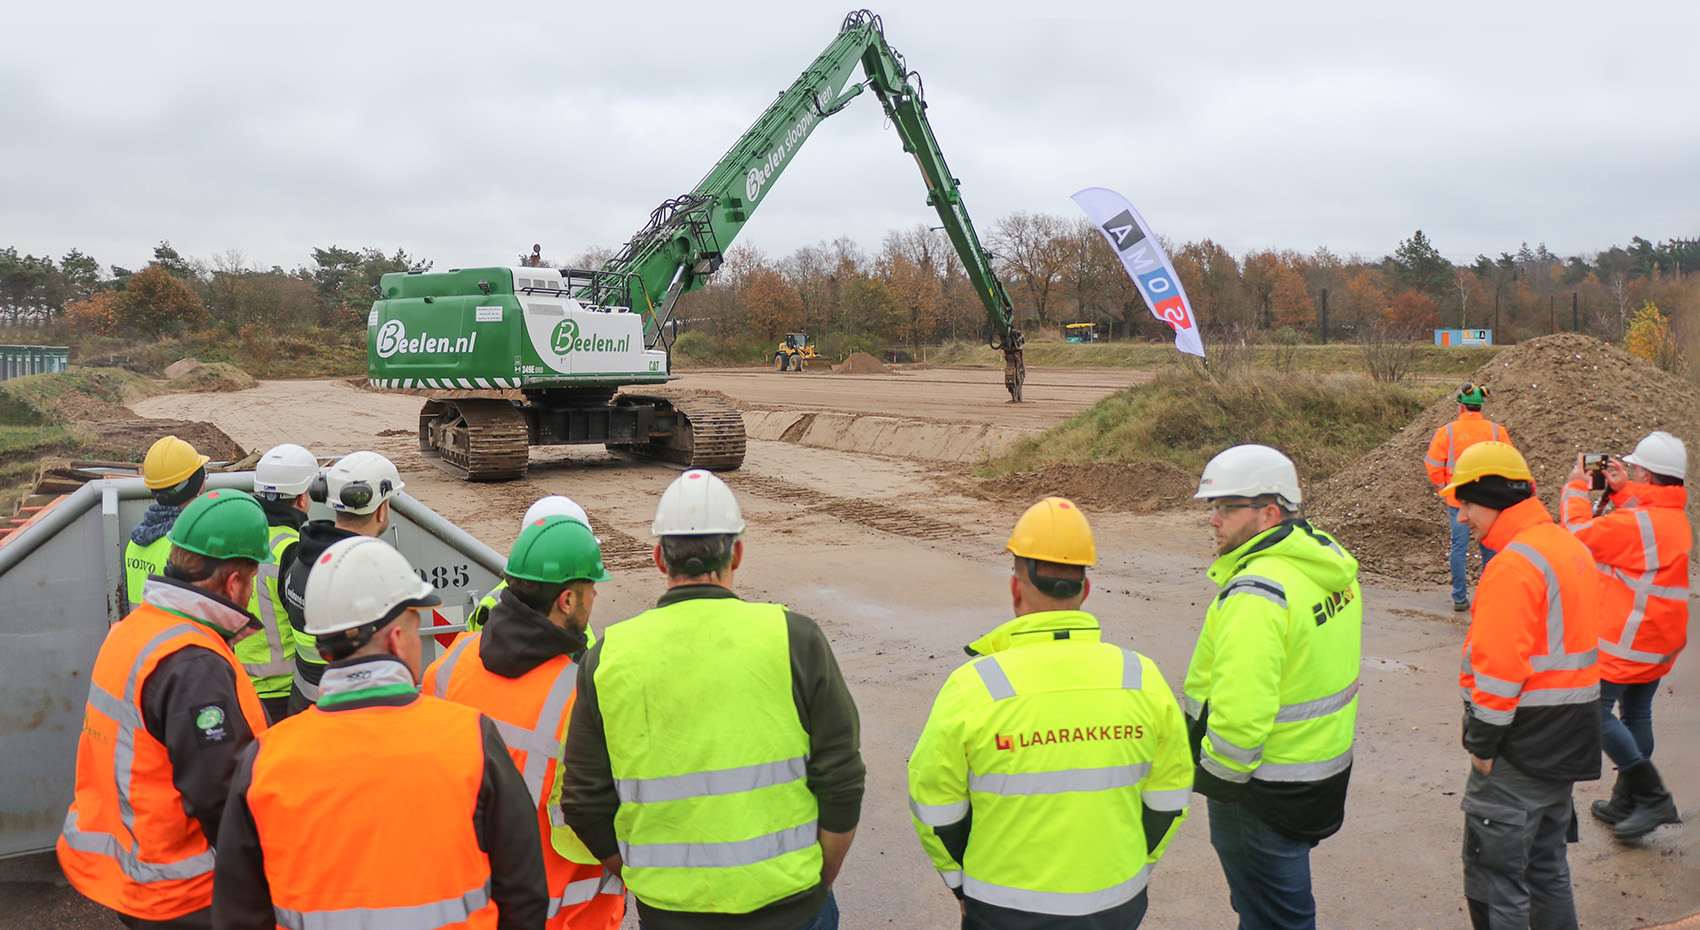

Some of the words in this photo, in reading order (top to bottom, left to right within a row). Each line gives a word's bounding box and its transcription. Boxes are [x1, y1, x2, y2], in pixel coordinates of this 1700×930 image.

[746, 144, 785, 202] Beelen
[785, 85, 833, 149] sloopweken
[376, 319, 477, 358] Beelen.nl
[550, 318, 630, 356] Beelen.nl
[127, 557, 156, 574] VOLVO
[1019, 725, 1144, 748] LAARAKKERS
